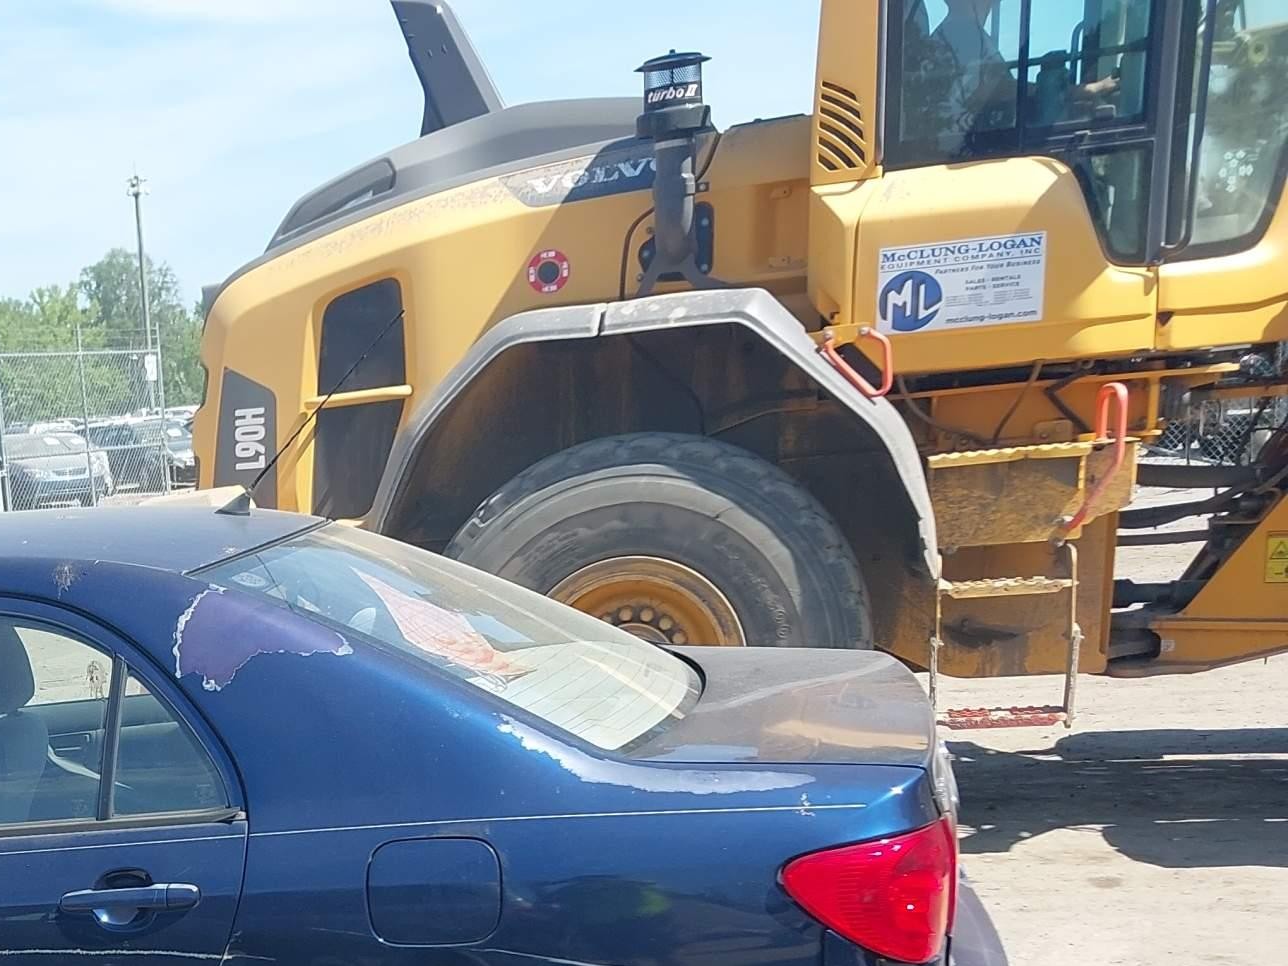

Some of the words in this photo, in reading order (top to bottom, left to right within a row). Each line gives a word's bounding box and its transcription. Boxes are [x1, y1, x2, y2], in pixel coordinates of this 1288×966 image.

[648, 86, 684, 103] turbo
[881, 236, 1043, 264] McCLUNG-LOGAN
[880, 258, 948, 271] EQUIPMENT
[235, 407, 266, 470] L90H
